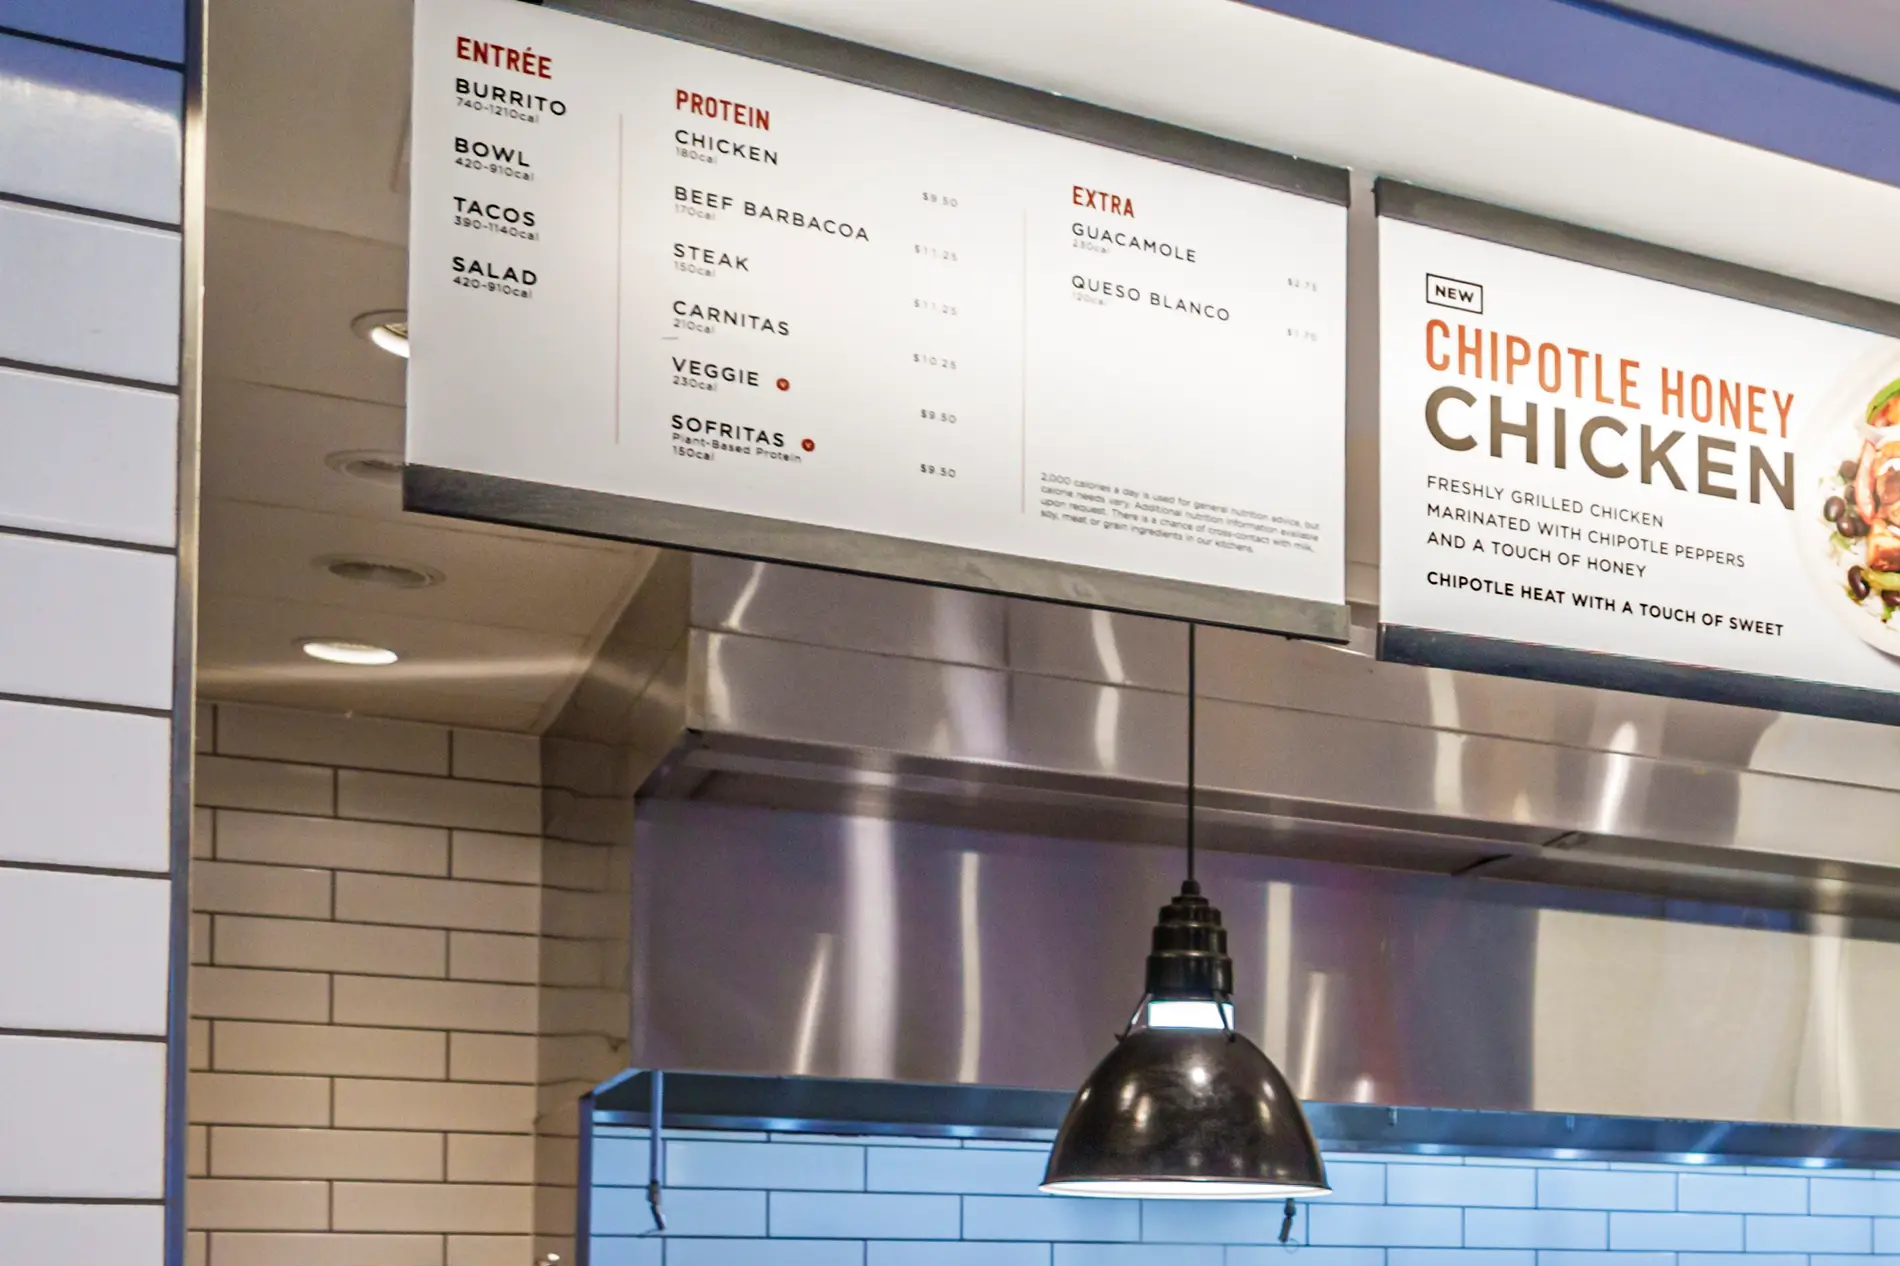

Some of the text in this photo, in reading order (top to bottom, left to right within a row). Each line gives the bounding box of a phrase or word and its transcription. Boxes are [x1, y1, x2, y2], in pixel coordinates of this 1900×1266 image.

[456, 36, 553, 80] ENTRÉE
[455, 78, 567, 116] BURRITO
[456, 97, 540, 123] 740-1210cal
[675, 88, 770, 131] PROTEIN
[454, 137, 531, 168] BOWL
[674, 129, 778, 165] CHICKEN
[454, 157, 535, 181] 420-910cal
[453, 196, 536, 227] TACOS
[674, 186, 869, 242] BEEF BARBACOA
[1072, 185, 1135, 218] EXTRA
[454, 215, 540, 241] 390-1140cal
[1071, 222, 1197, 263] GUACAMOLE
[452, 256, 538, 285] SALAD
[673, 243, 749, 272] STEAK
[453, 276, 534, 298] 420-910cal
[1071, 275, 1231, 321] QUESO BLANCO
[1435, 284, 1474, 304] NEW
[672, 300, 790, 336] CARNITAS
[672, 356, 759, 387] VEGGIE
[1426, 318, 1795, 439] CHIPOTLE HONEY
[671, 414, 785, 448] SOFRITAS
[671, 433, 802, 463] Plant-Based Protein
[1425, 385, 1795, 511] CHICKEN
[1427, 475, 1664, 528] FRESHLY GRILLED CHICKEN
[1427, 503, 1745, 568] MARINATED WITH CHIPOTLE PEPPERS
[1427, 531, 1646, 577] AND A TOUCH OF HONEY
[1427, 571, 1784, 637] CHIPOTLE HEAT WITH A TOUCH OF SWEET
